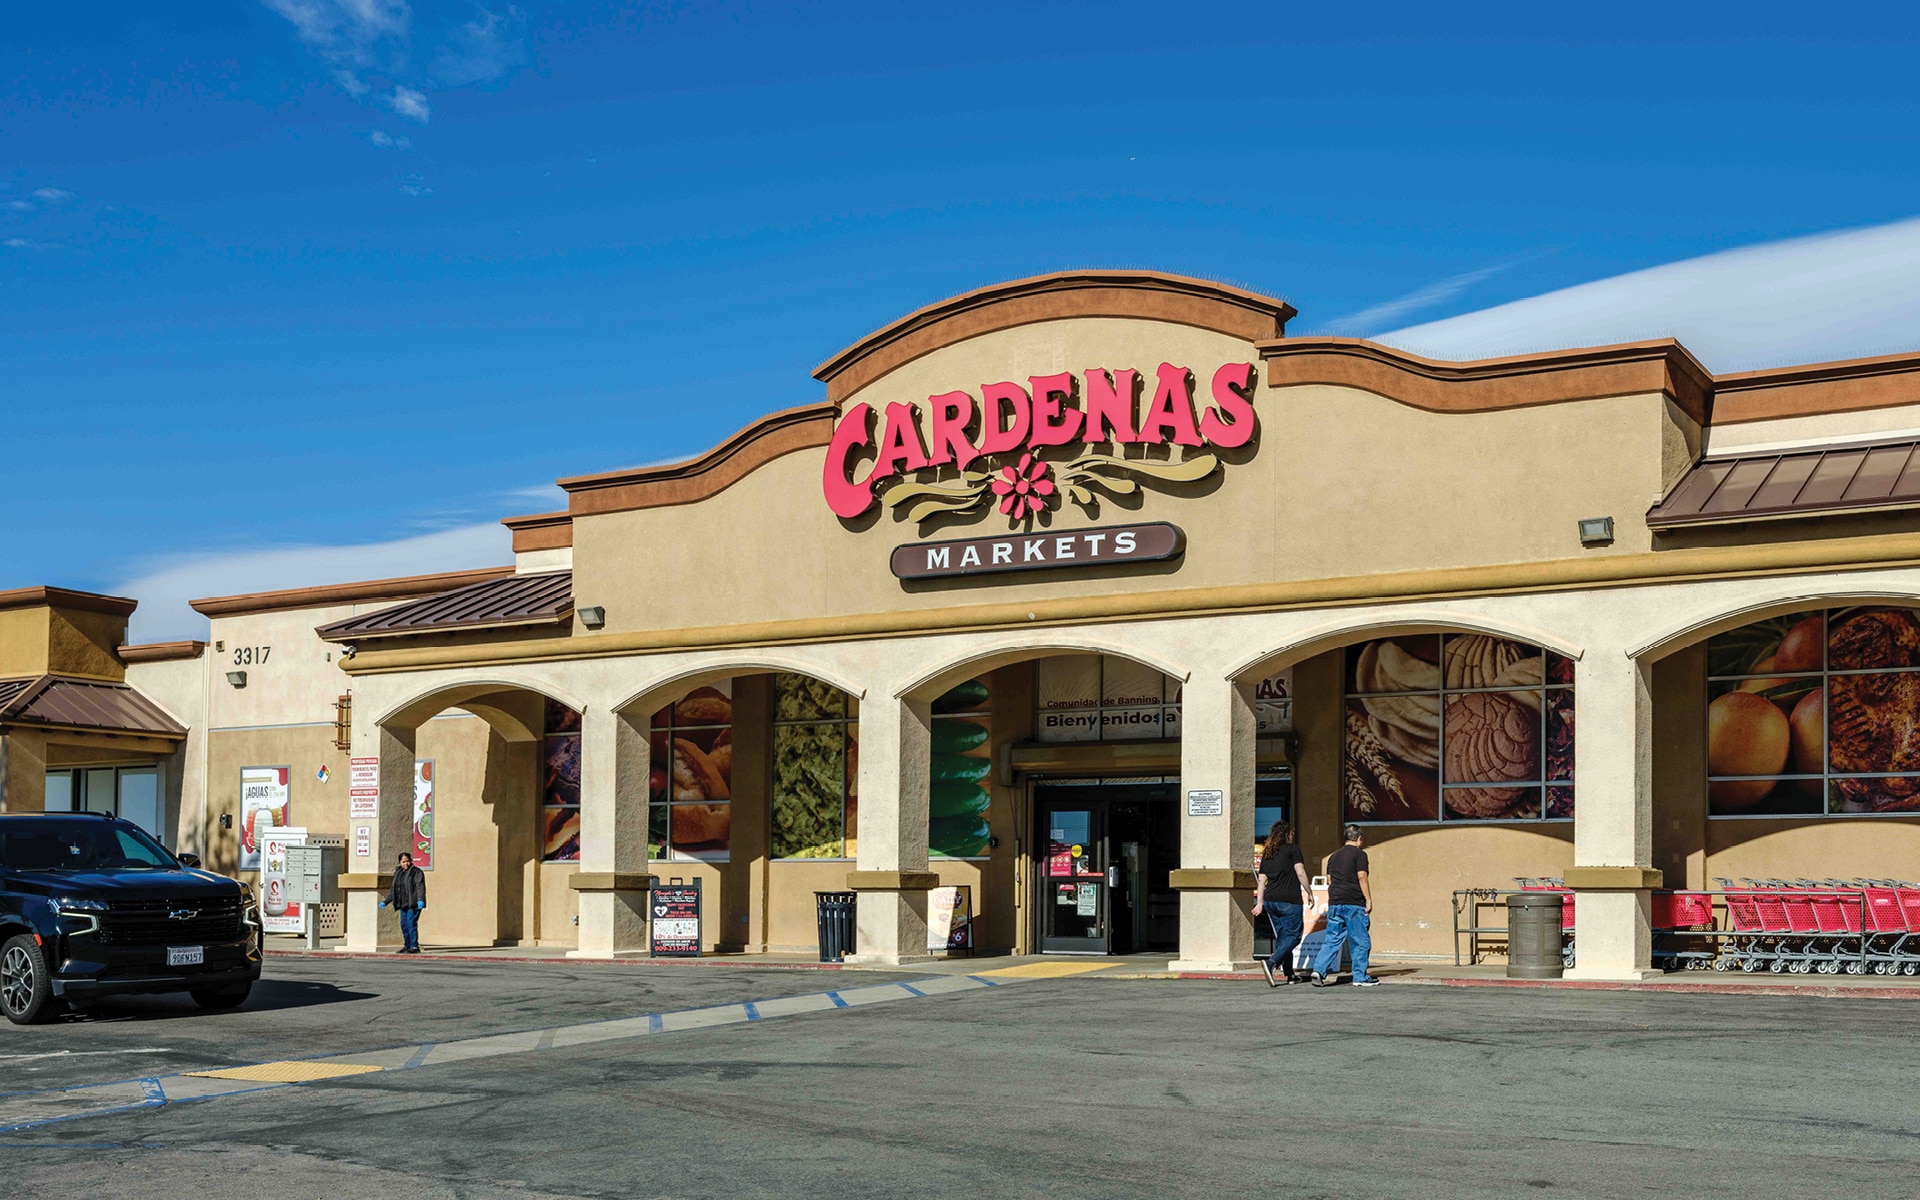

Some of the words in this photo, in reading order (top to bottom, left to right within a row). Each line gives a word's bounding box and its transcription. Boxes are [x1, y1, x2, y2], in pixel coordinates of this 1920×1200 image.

[822, 361, 1256, 518] CARDENAS
[926, 531, 1138, 570] MARKETS
[233, 646, 271, 666] 3317
[1103, 698, 1115, 706] de
[1118, 695, 1160, 705] Banning,
[1046, 712, 1160, 727] Bienvenidos
[1166, 713, 1176, 722] a
[245, 786, 269, 800] ¡AGUAS
